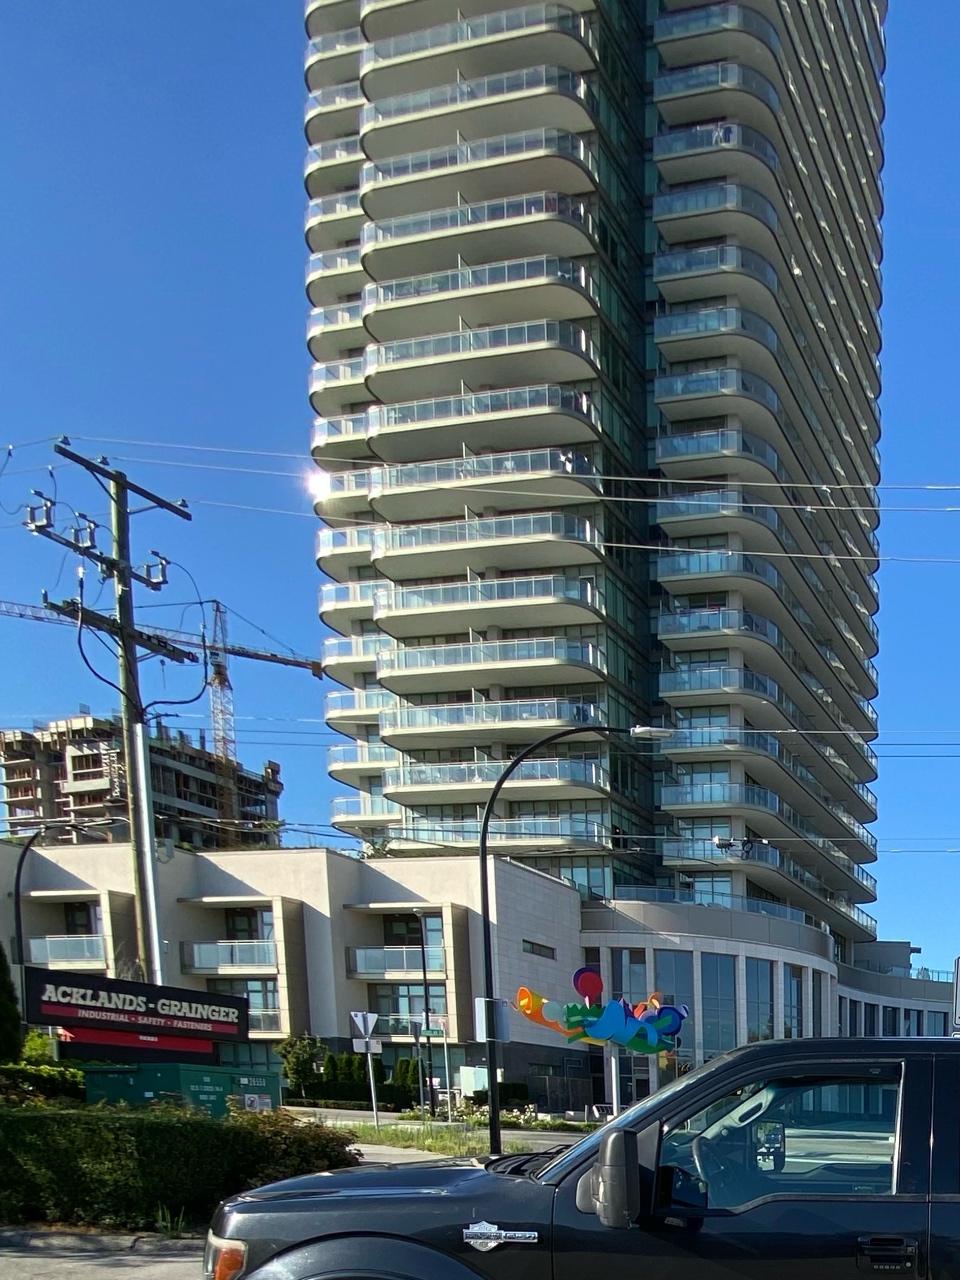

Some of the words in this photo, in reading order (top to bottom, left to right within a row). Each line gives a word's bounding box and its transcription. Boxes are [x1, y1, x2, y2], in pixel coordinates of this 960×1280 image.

[41, 984, 146, 1012] ACKLANDS
[157, 999, 239, 1022] GRAINGER
[77, 1009, 129, 1023] INDUSTRIAL
[137, 1016, 165, 1026] SAFETY
[173, 1021, 213, 1031] FASTENERS
